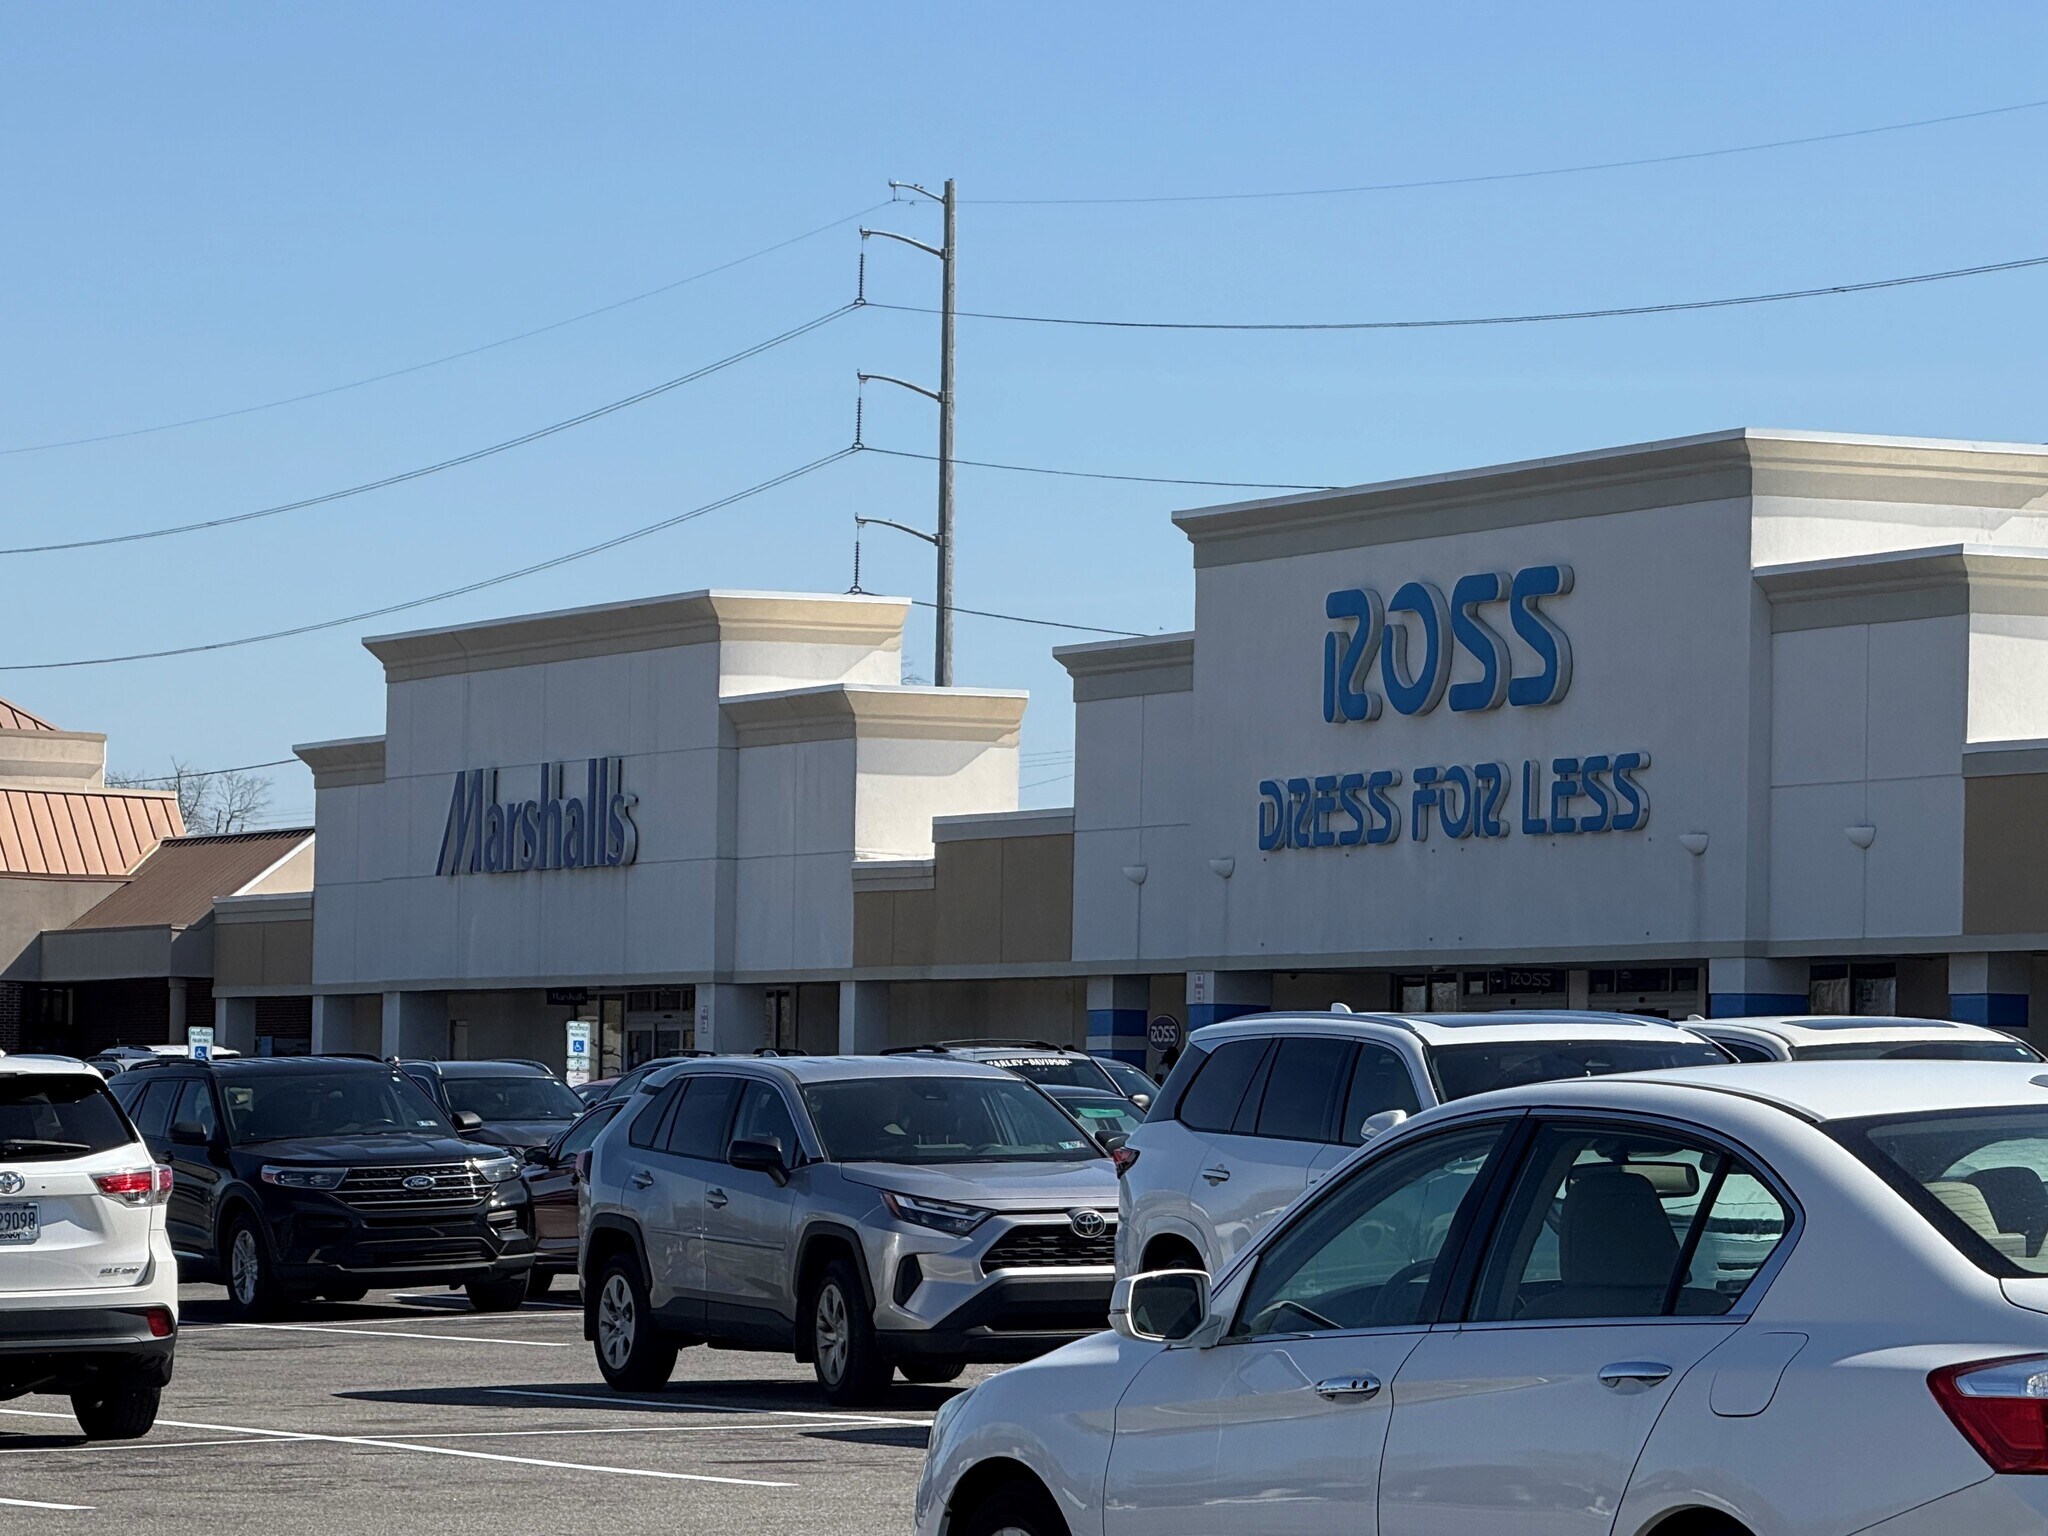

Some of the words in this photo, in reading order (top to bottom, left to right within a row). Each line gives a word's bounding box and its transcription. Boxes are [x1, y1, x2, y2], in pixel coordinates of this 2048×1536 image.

[1323, 564, 1574, 723] ROSS
[436, 757, 636, 876] Marshalls
[1259, 769, 1402, 850] DRESS
[1412, 762, 1511, 841] FOR
[1522, 752, 1651, 835] LESS
[1510, 972, 1551, 987] ROSS
[1150, 1025, 1176, 1043] ROSS
